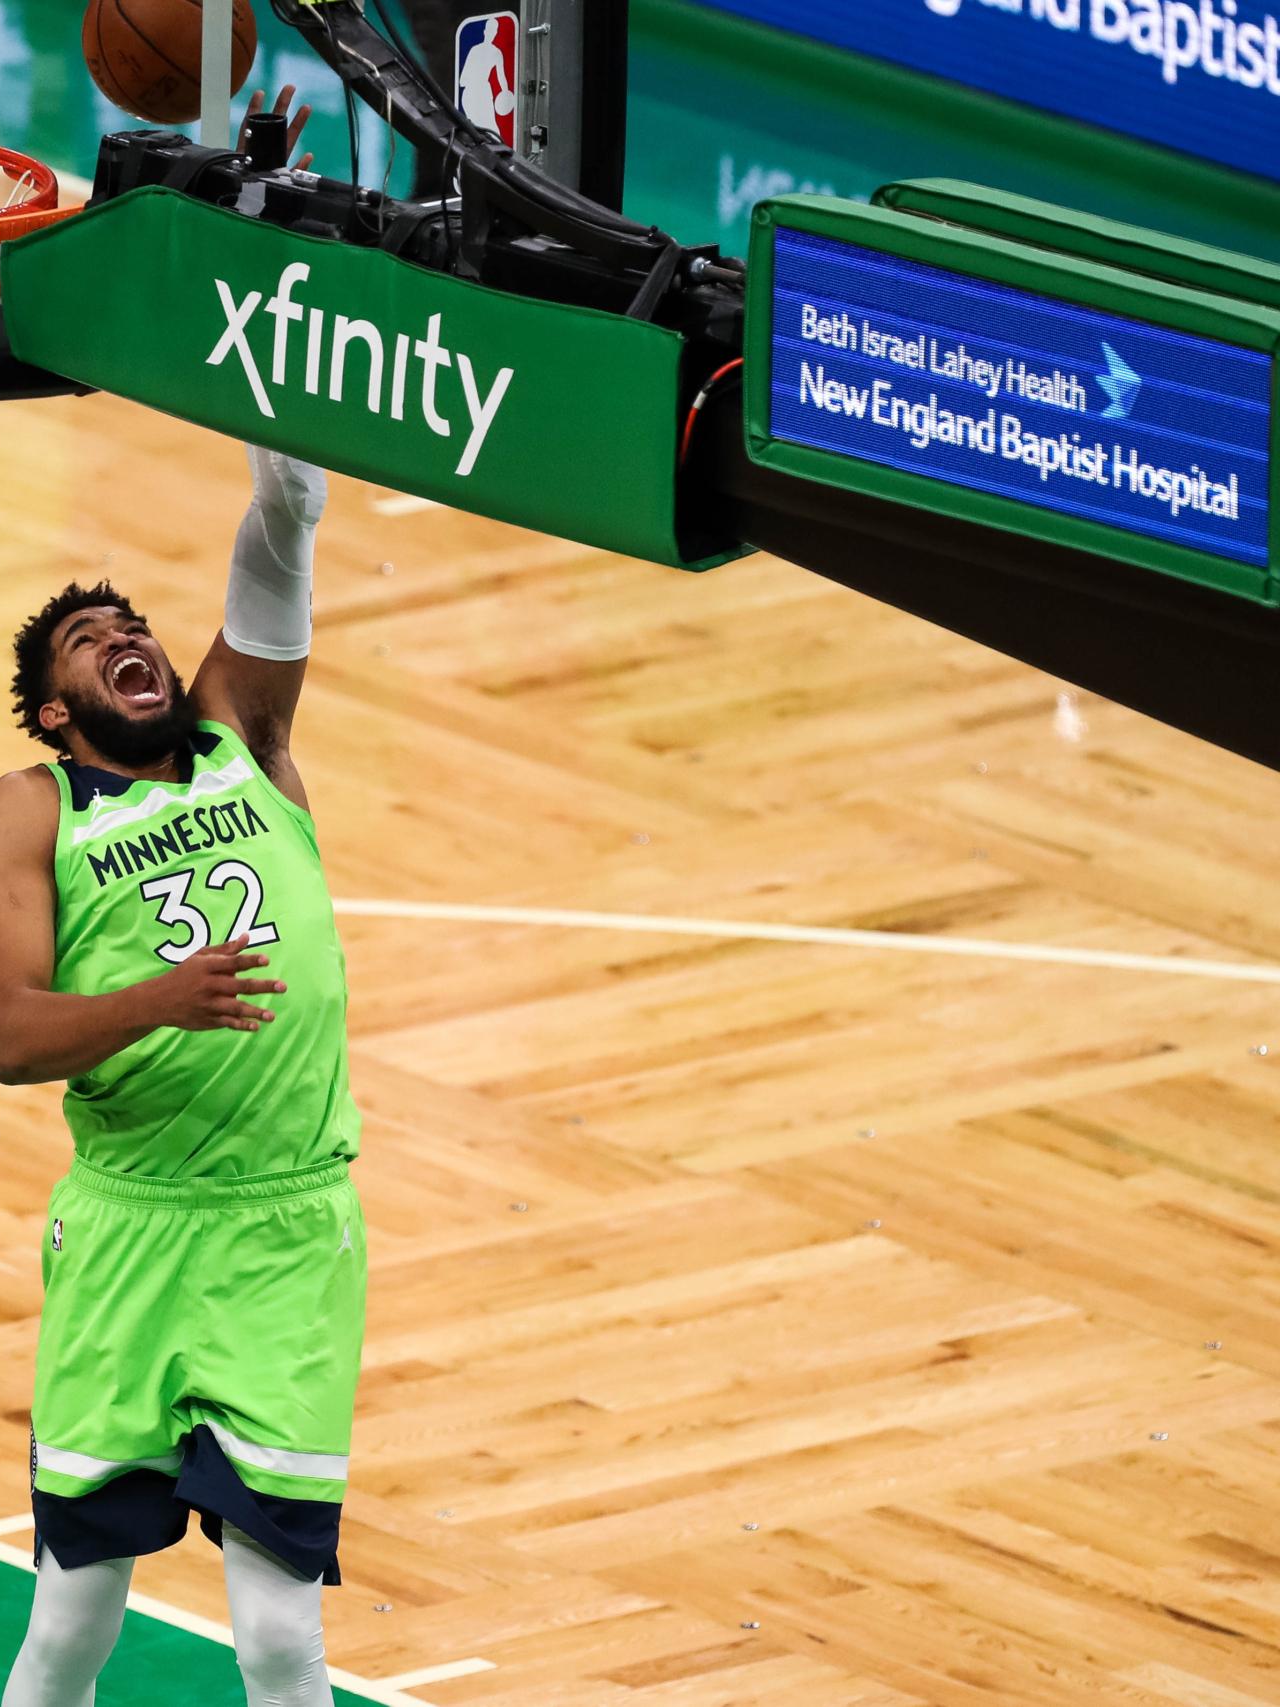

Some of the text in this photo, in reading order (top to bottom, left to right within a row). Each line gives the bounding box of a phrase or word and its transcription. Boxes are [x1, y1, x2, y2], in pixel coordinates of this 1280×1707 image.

[206, 262, 514, 476] xfinity
[801, 304, 1087, 413] Beth Israel Lahey Health
[799, 362, 1240, 521] New England Baptist Hospital
[86, 797, 270, 887] MINNESOTA
[140, 859, 280, 965] 32
